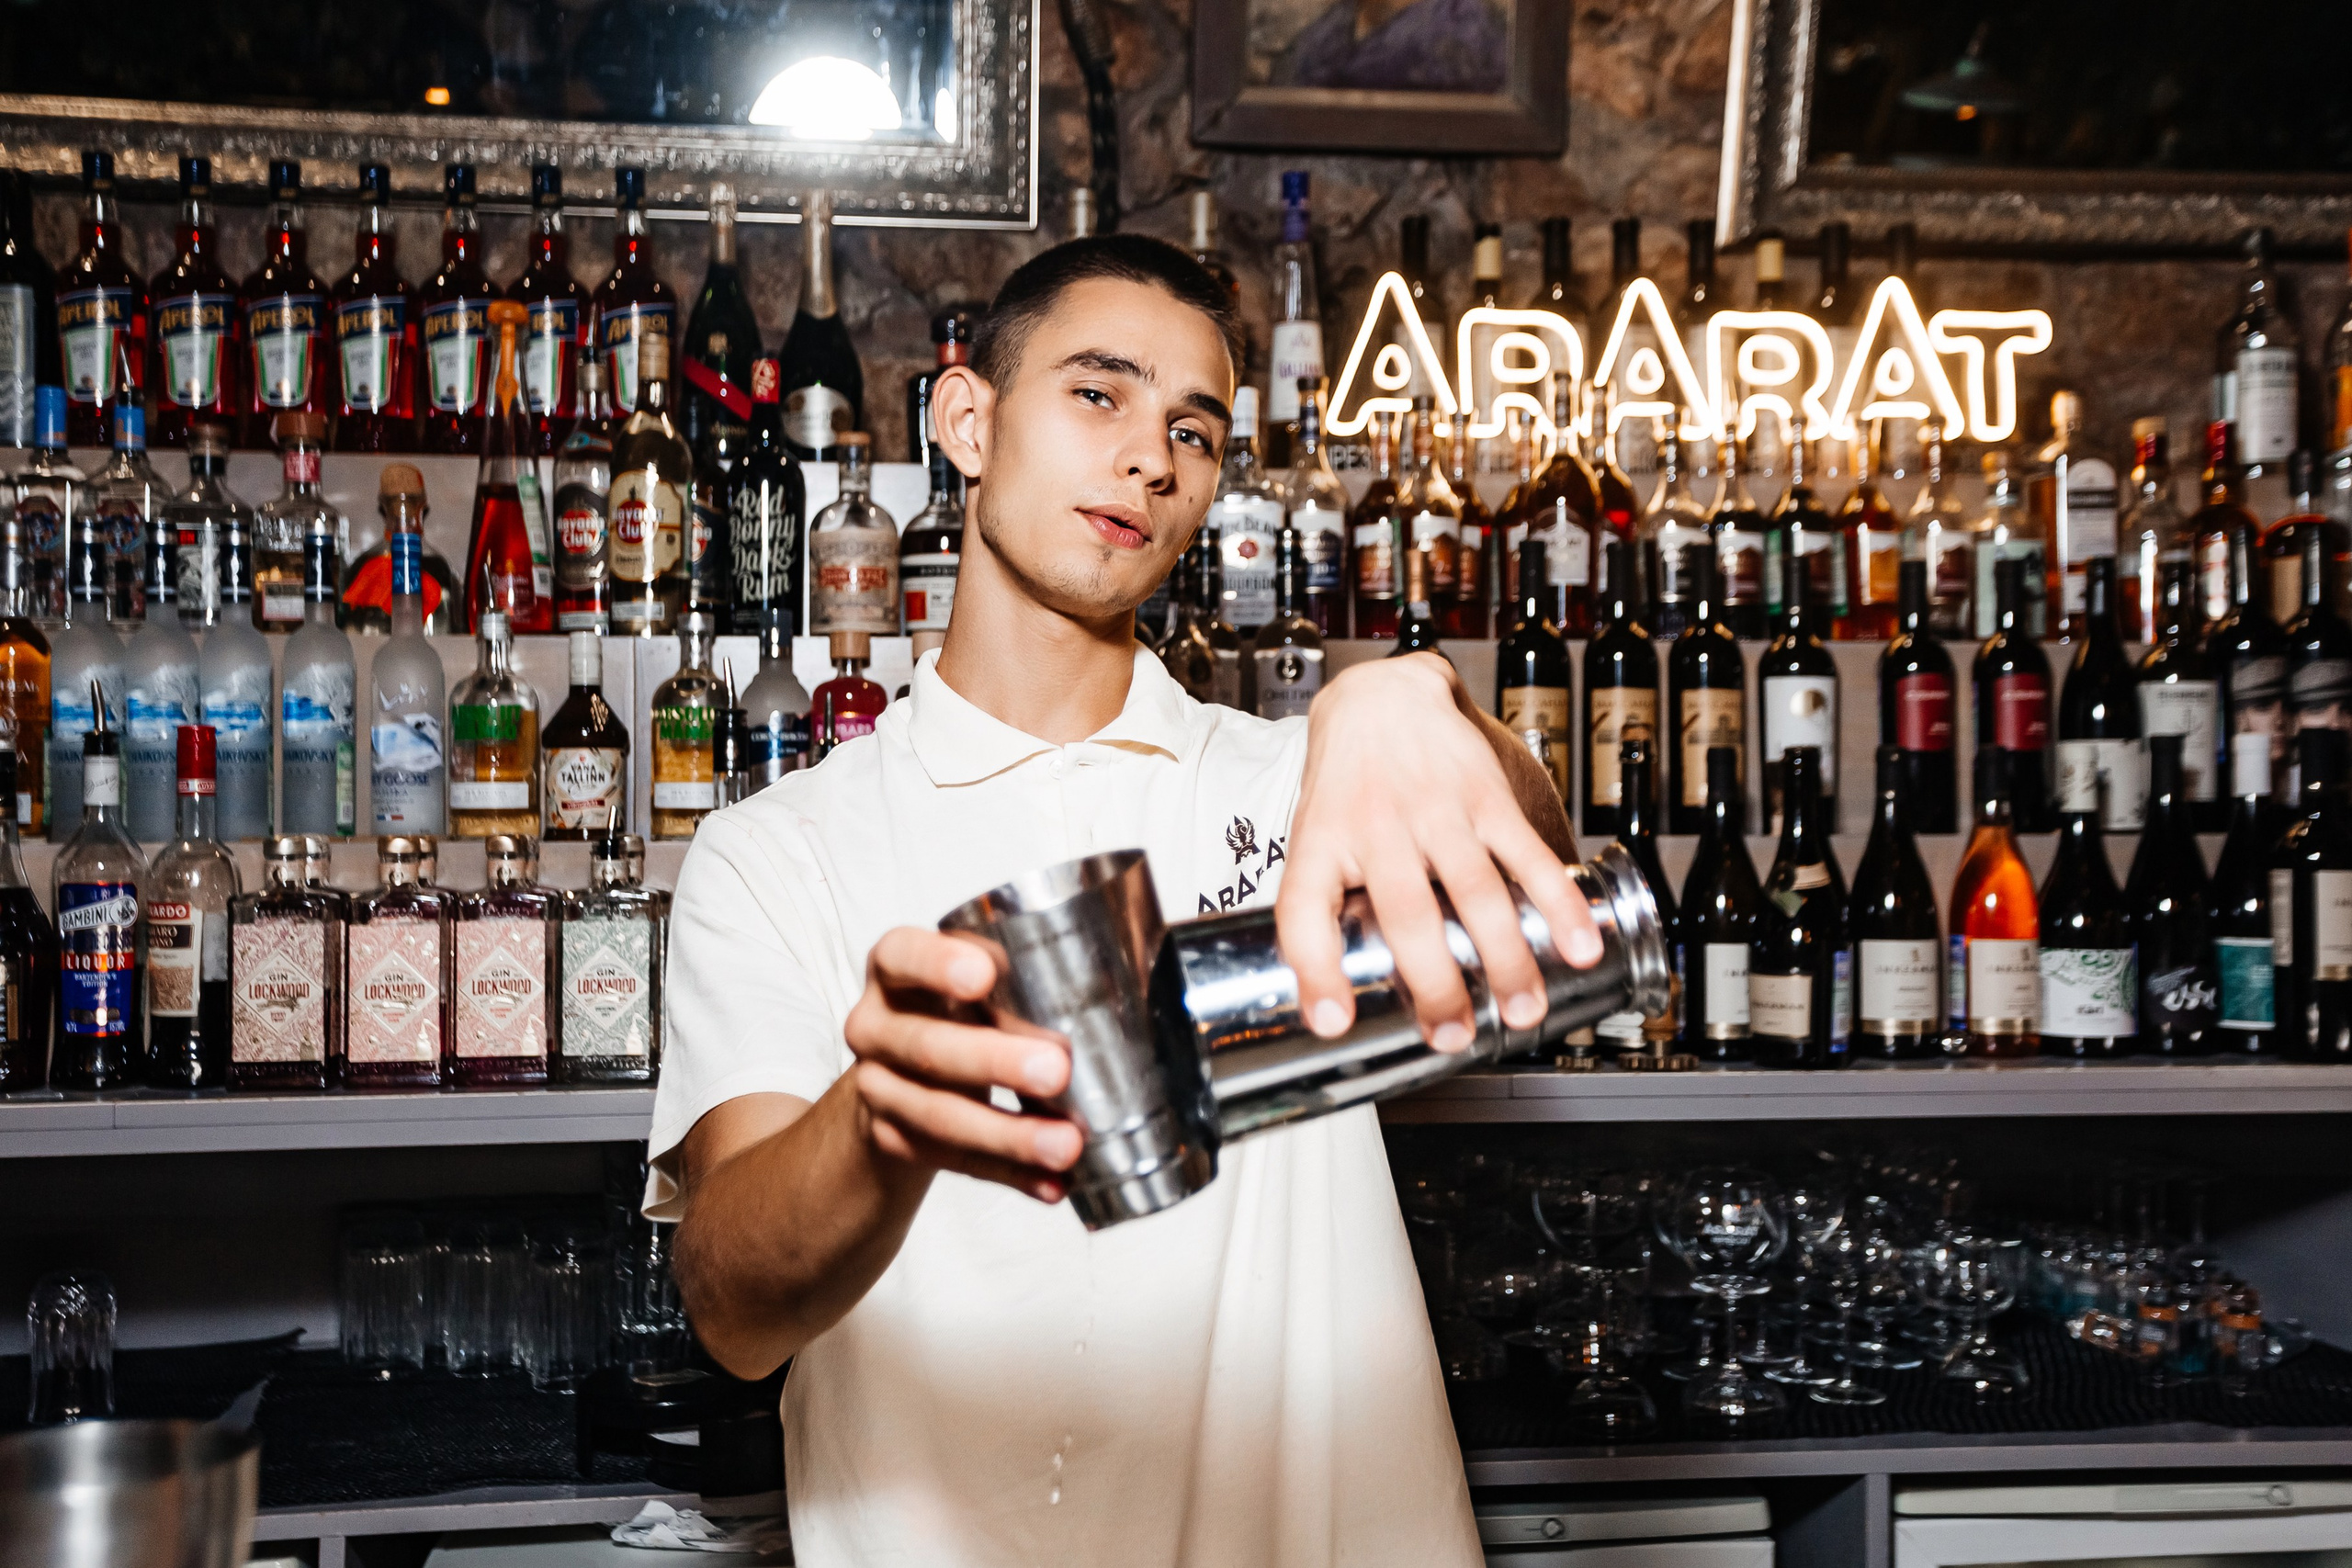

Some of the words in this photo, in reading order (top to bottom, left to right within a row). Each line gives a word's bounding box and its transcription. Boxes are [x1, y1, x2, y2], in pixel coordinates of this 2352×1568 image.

[1325, 269, 2054, 443] ARARAT
[560, 771, 605, 784] TALLINN
[61, 904, 107, 930] GAMBINI
[65, 953, 126, 972] LIQUOR
[491, 969, 511, 977] GIN
[596, 968, 616, 976] GIN
[268, 974, 288, 982] GIN
[384, 974, 404, 982] GIN
